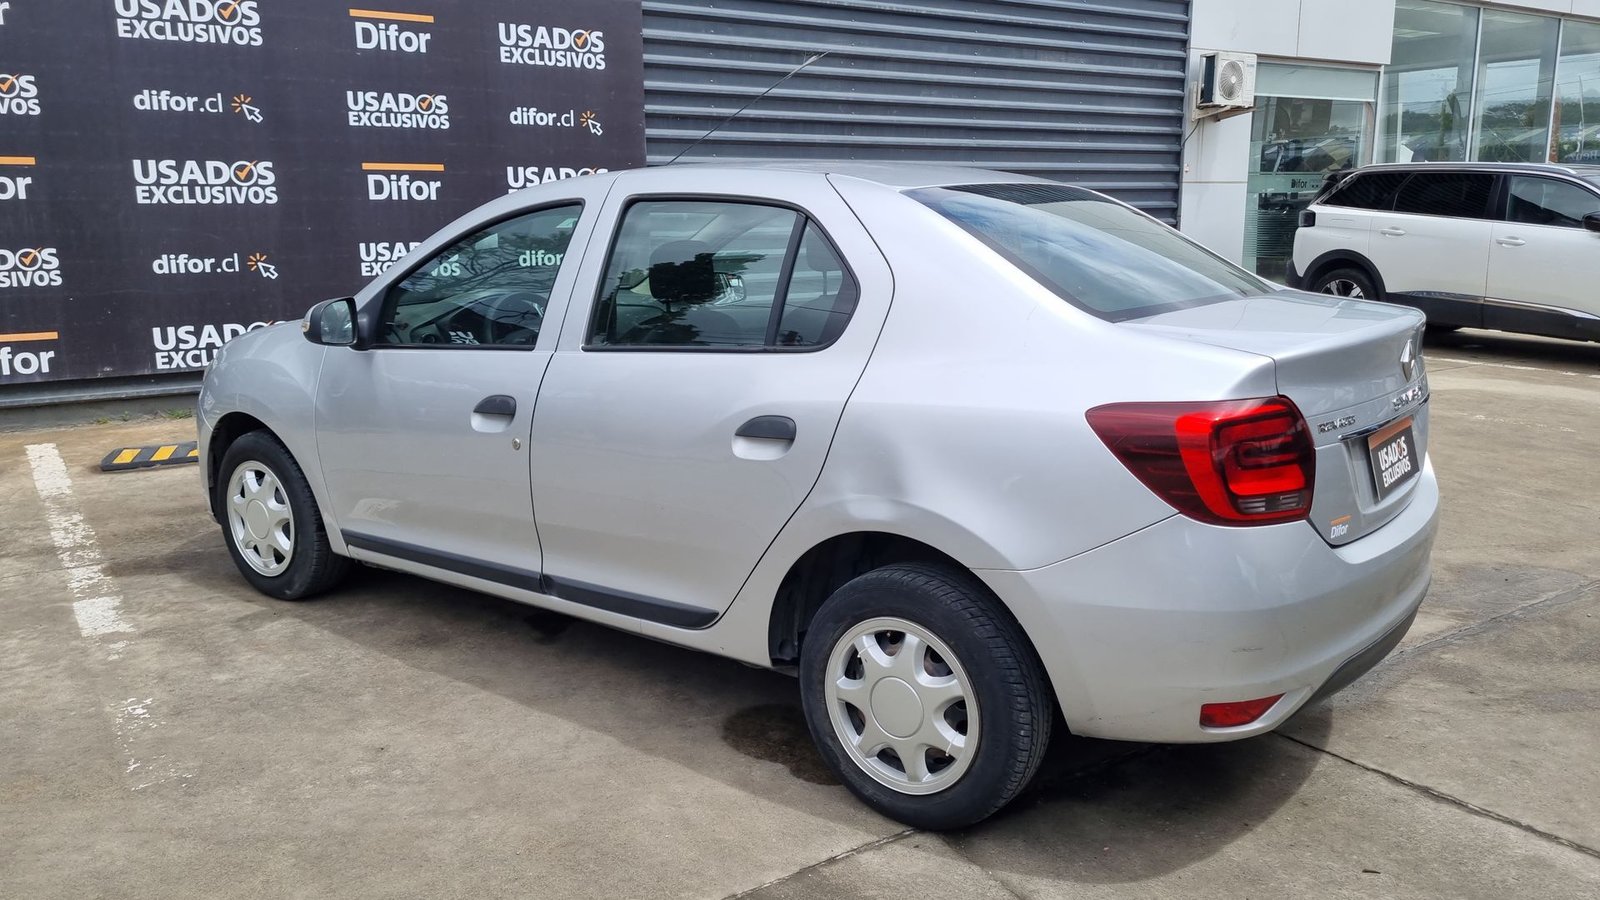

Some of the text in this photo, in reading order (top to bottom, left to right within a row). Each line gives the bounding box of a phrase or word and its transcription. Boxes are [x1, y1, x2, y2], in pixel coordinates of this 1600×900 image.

[114, 0, 261, 26] USADOS
[116, 18, 263, 46] EXCLUSIVOS
[354, 21, 431, 53] Difor
[498, 22, 605, 53] USADOS
[500, 46, 606, 70] EXCLUSIVOS
[133, 90, 223, 113] difor.cl
[347, 91, 448, 115] USADOS
[348, 111, 450, 129] EXCLUSIVOS
[509, 107, 575, 127] difor.cl
[132, 159, 275, 186] USADOS
[507, 166, 609, 188] USAD
[135, 185, 278, 205] EXCLUSIVOS
[367, 174, 441, 201] Difor
[152, 252, 239, 274] difor.cl
[152, 320, 286, 351] USAD
[1378, 436, 1408, 471] USADOS
[1382, 455, 1411, 488] EXCLUSIVOS
[1330, 524, 1348, 539] Difor
